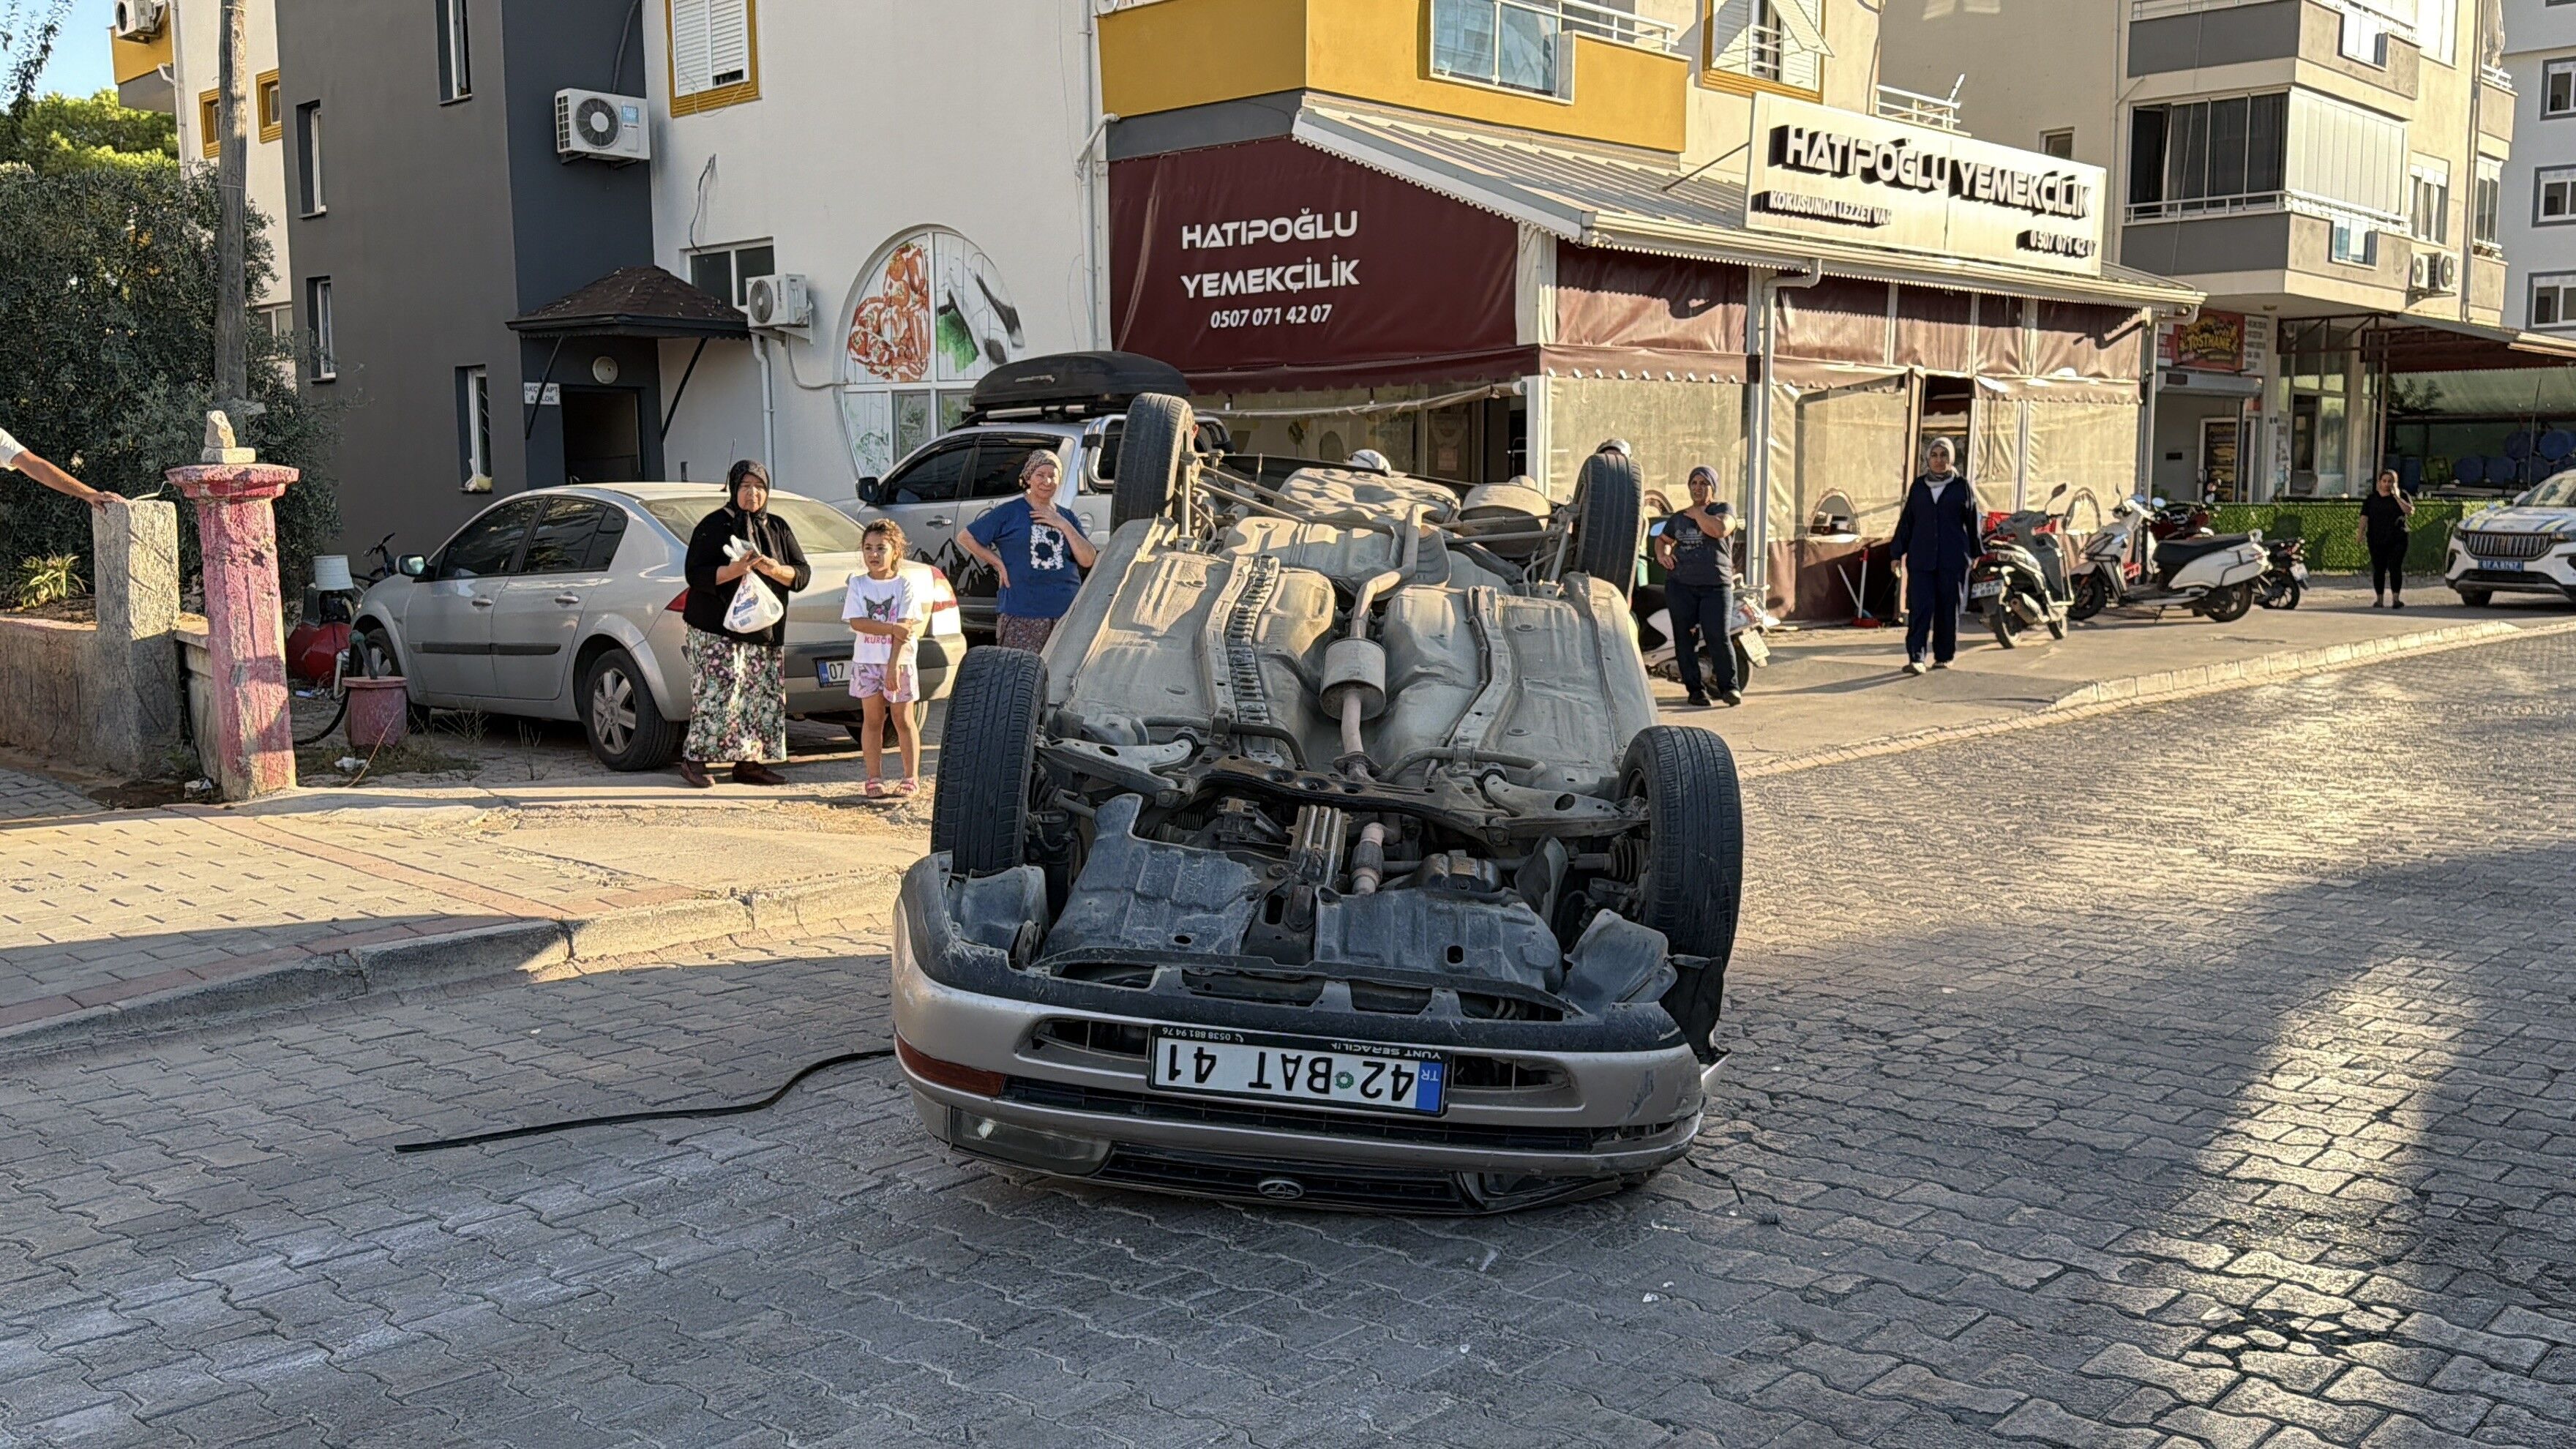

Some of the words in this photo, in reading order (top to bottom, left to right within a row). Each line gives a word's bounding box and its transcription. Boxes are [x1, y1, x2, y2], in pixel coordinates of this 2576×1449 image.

[1769, 190, 1836, 218] KOKUSUNDA
[1838, 201, 1873, 224] LEZZET
[1181, 207, 1359, 250] HATIPOĞLU
[1180, 255, 1360, 299] YEMEKÇİLİK
[1210, 309, 1248, 329] 0507
[1252, 307, 1282, 326] 071
[1286, 305, 1306, 324] 42
[1311, 304, 1333, 323] 07
[864, 636, 894, 644] KUROM
[828, 662, 845, 679] 07
[1162, 1027, 1174, 1036] 76
[1176, 1028, 1187, 1037] 94
[1190, 1030, 1206, 1038] 881
[1208, 1033, 1231, 1041] 0538
[1404, 1049, 1442, 1060] YUNT
[1168, 1044, 1217, 1084] 41
[1248, 1051, 1333, 1095] BAT
[1360, 1060, 1415, 1101] 42
[1420, 1068, 1440, 1082] TR
